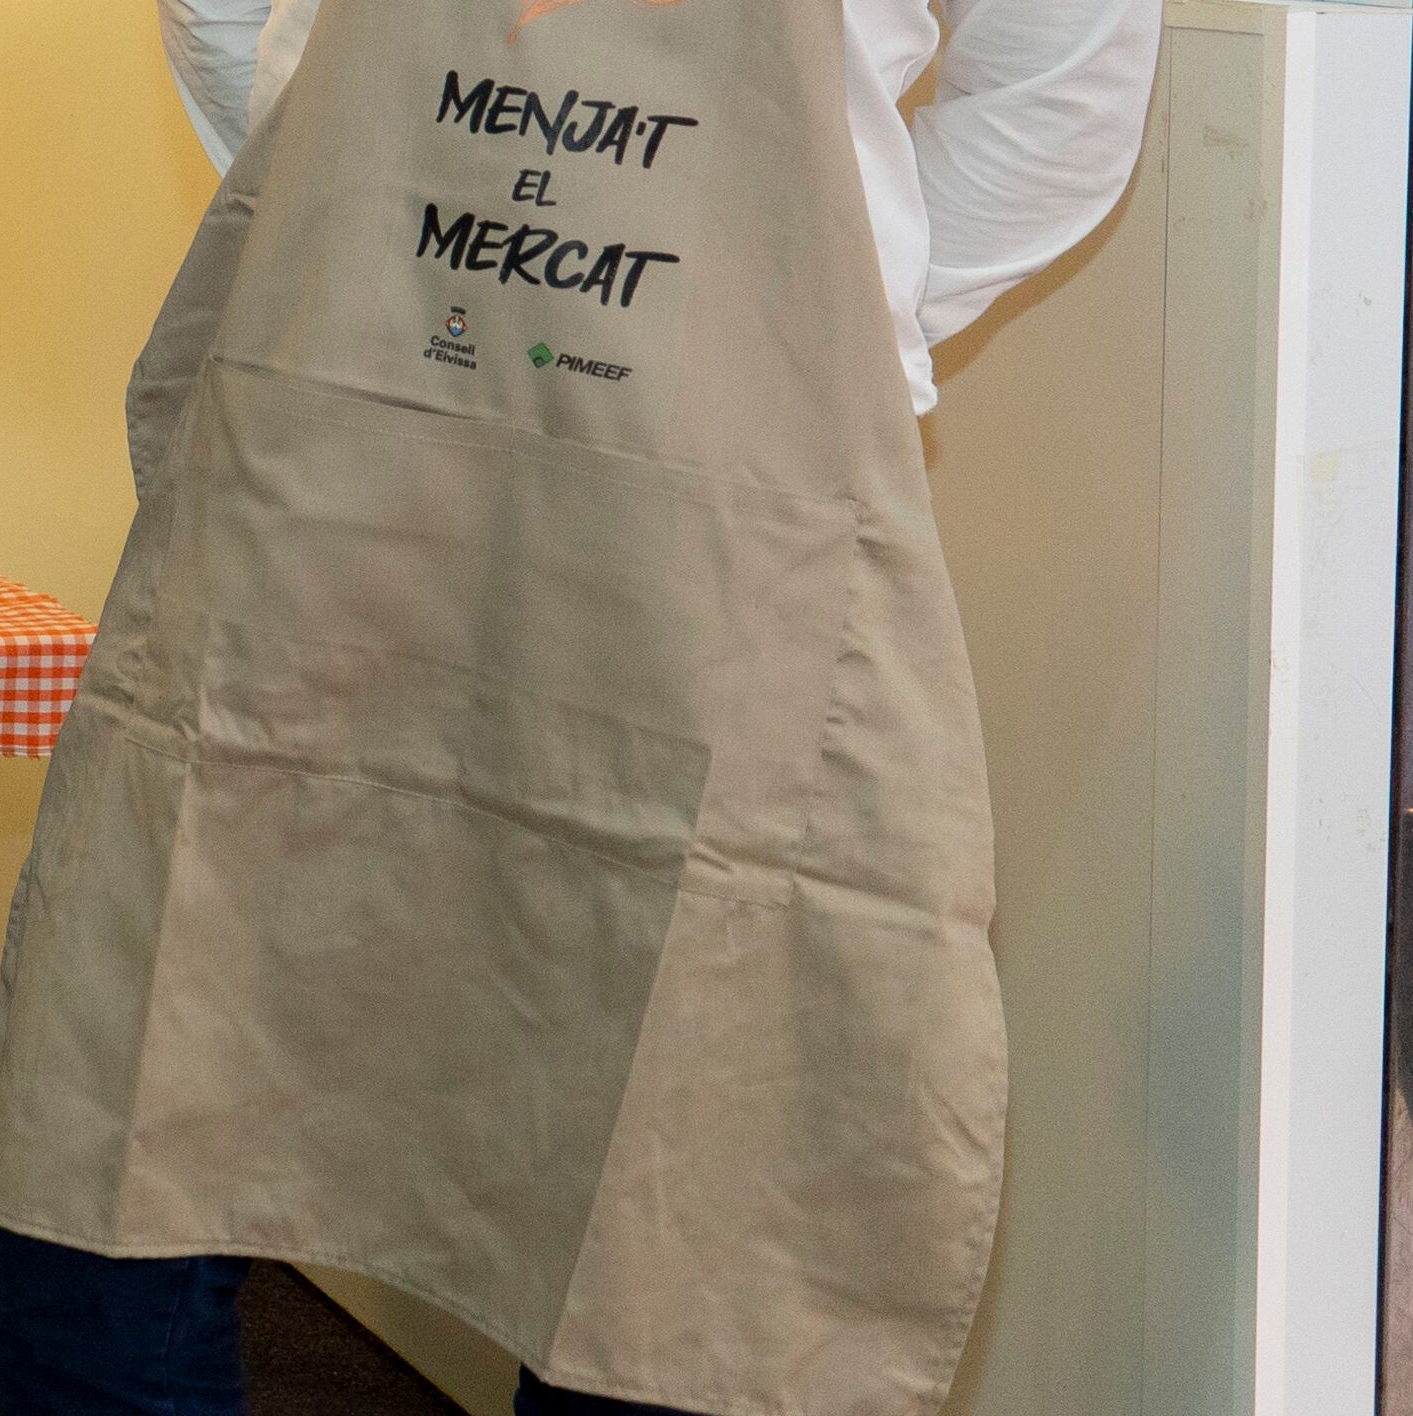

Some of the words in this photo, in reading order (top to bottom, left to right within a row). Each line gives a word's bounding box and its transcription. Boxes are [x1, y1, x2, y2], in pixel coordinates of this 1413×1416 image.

[435, 70, 700, 169] MENJA'T
[511, 168, 556, 207] EL
[415, 203, 681, 308] MERCAT
[423, 345, 477, 370] d'Eivissa
[429, 334, 475, 356] Consell
[554, 353, 633, 383] PIMEEF
